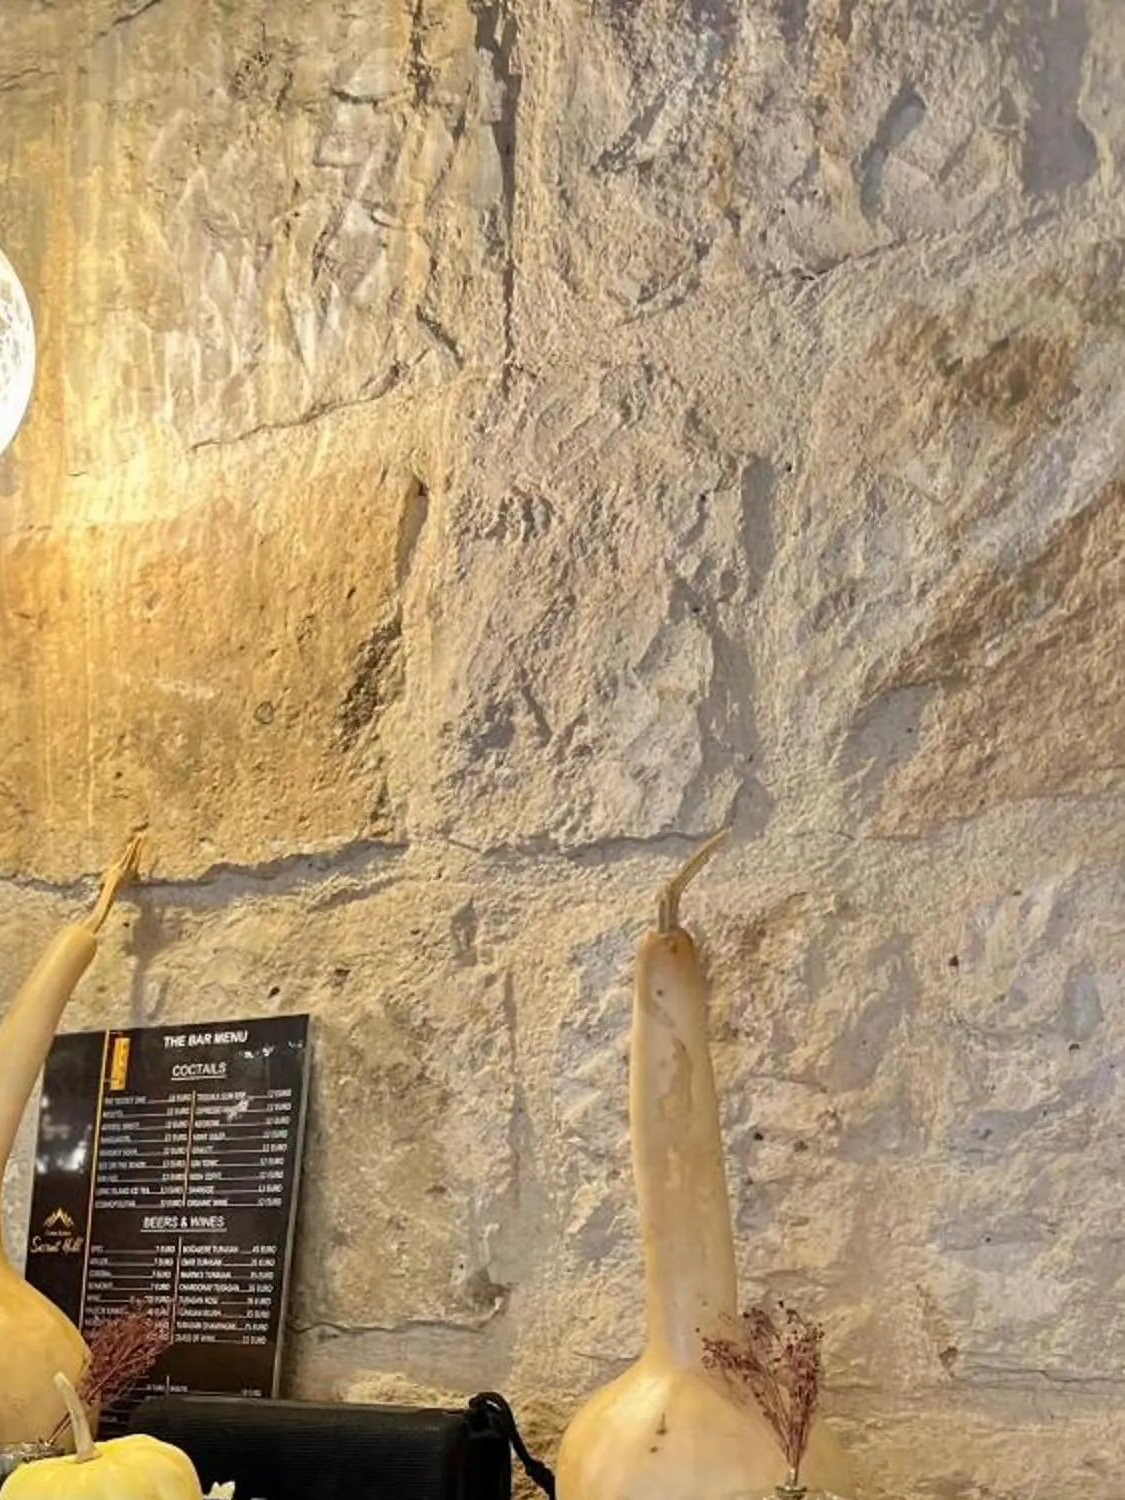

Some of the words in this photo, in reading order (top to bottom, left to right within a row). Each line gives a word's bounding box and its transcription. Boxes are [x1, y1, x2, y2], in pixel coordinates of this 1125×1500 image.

[163, 1035, 186, 1049] THE
[188, 1034, 212, 1047] BAR
[213, 1030, 248, 1045] MENU
[171, 1062, 227, 1077] COCTAILS
[142, 1215, 178, 1229] BEERS
[180, 1215, 188, 1228] &
[190, 1215, 225, 1228] WINES
